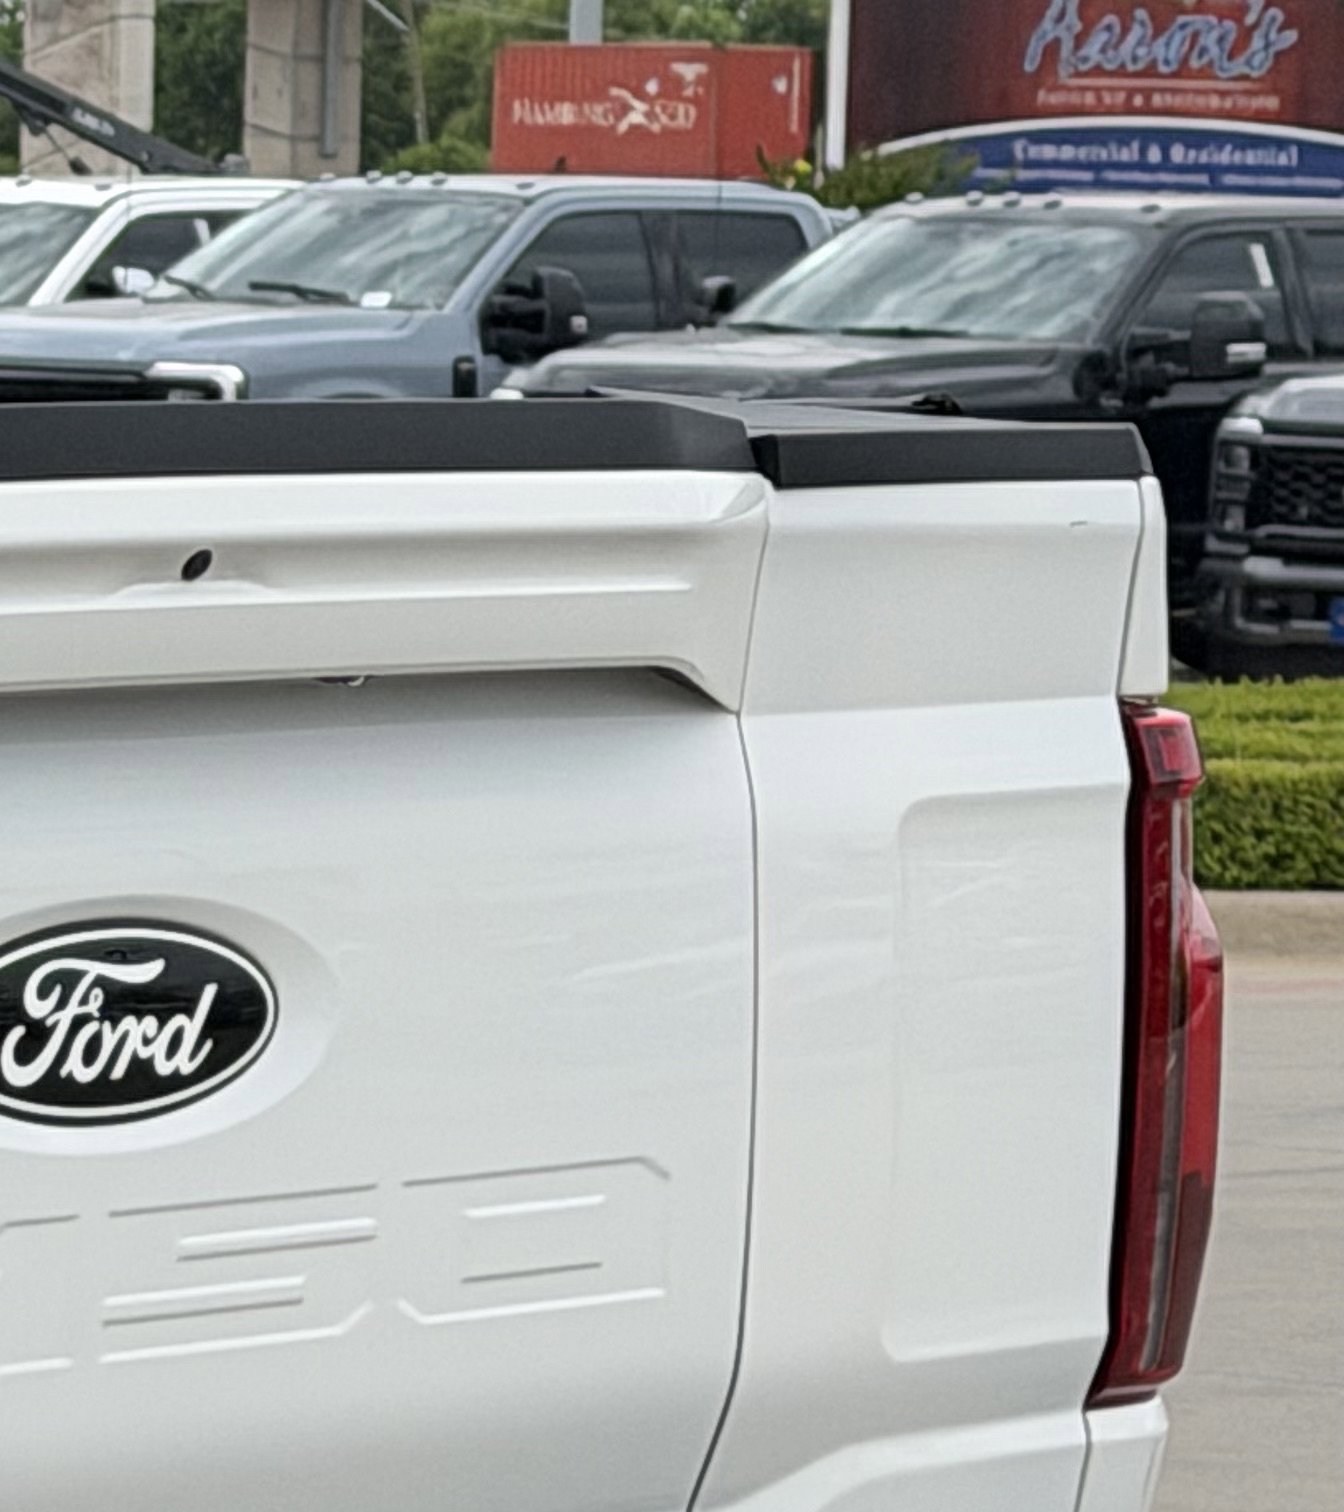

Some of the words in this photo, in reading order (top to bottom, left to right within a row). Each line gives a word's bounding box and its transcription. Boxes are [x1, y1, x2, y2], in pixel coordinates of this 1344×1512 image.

[1023, 0, 1299, 79] Aaron's
[1014, 138, 1140, 163] Commercial
[1170, 142, 1298, 167] Residential
[0, 957, 218, 1088] Ford
